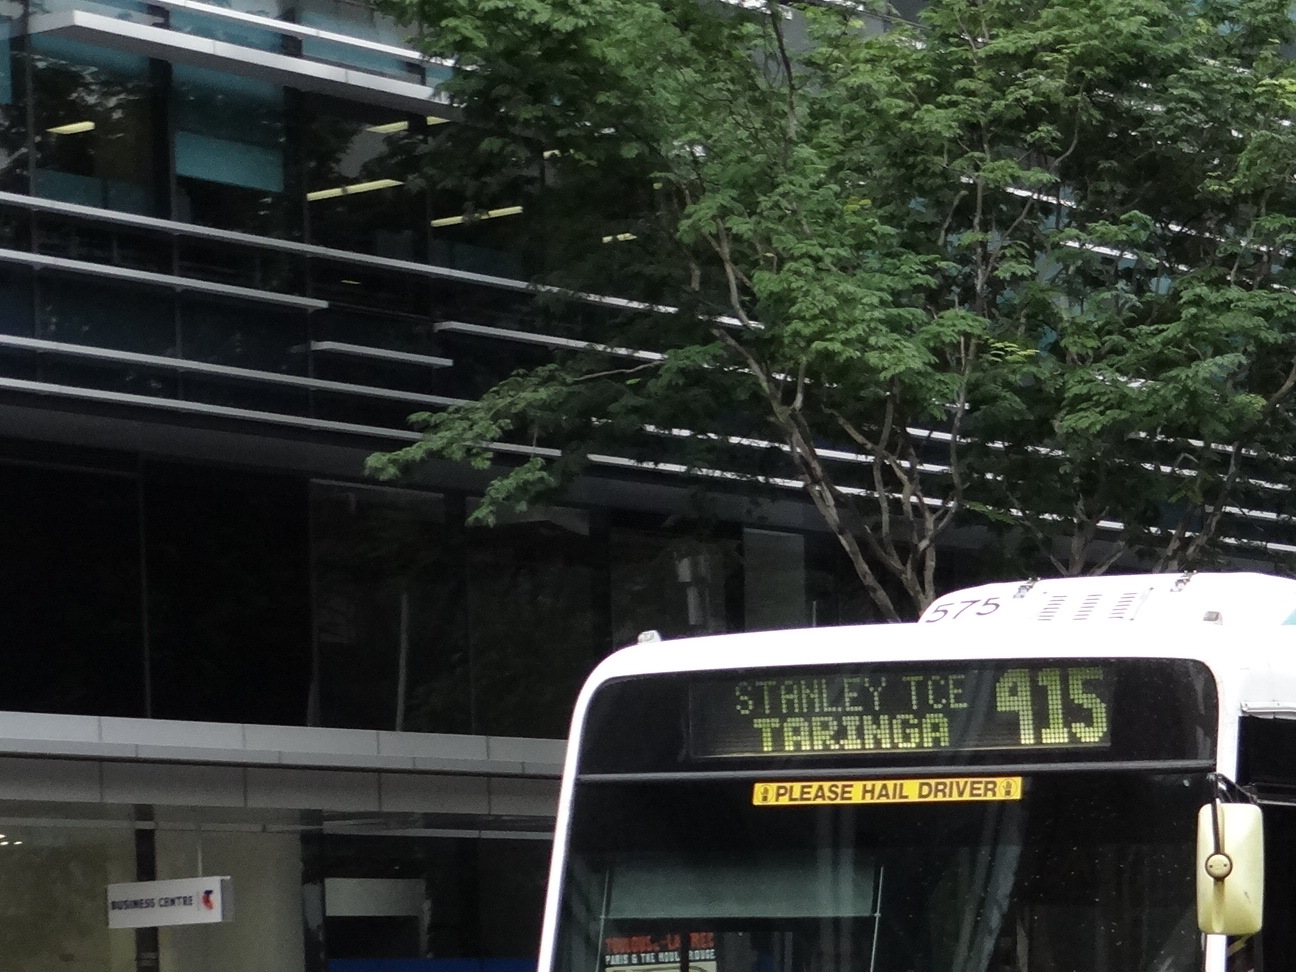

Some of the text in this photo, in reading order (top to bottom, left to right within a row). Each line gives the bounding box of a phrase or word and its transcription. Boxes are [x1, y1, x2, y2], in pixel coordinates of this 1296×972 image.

[925, 597, 1000, 623] 575
[735, 674, 967, 714] STANLEY TCE
[753, 713, 950, 752] TARINGA
[775, 779, 998, 803] PLEASE HAIL DRIVER
[111, 899, 155, 910] BUSINESS
[605, 954, 628, 965] PARIS
[641, 952, 655, 963] THE
